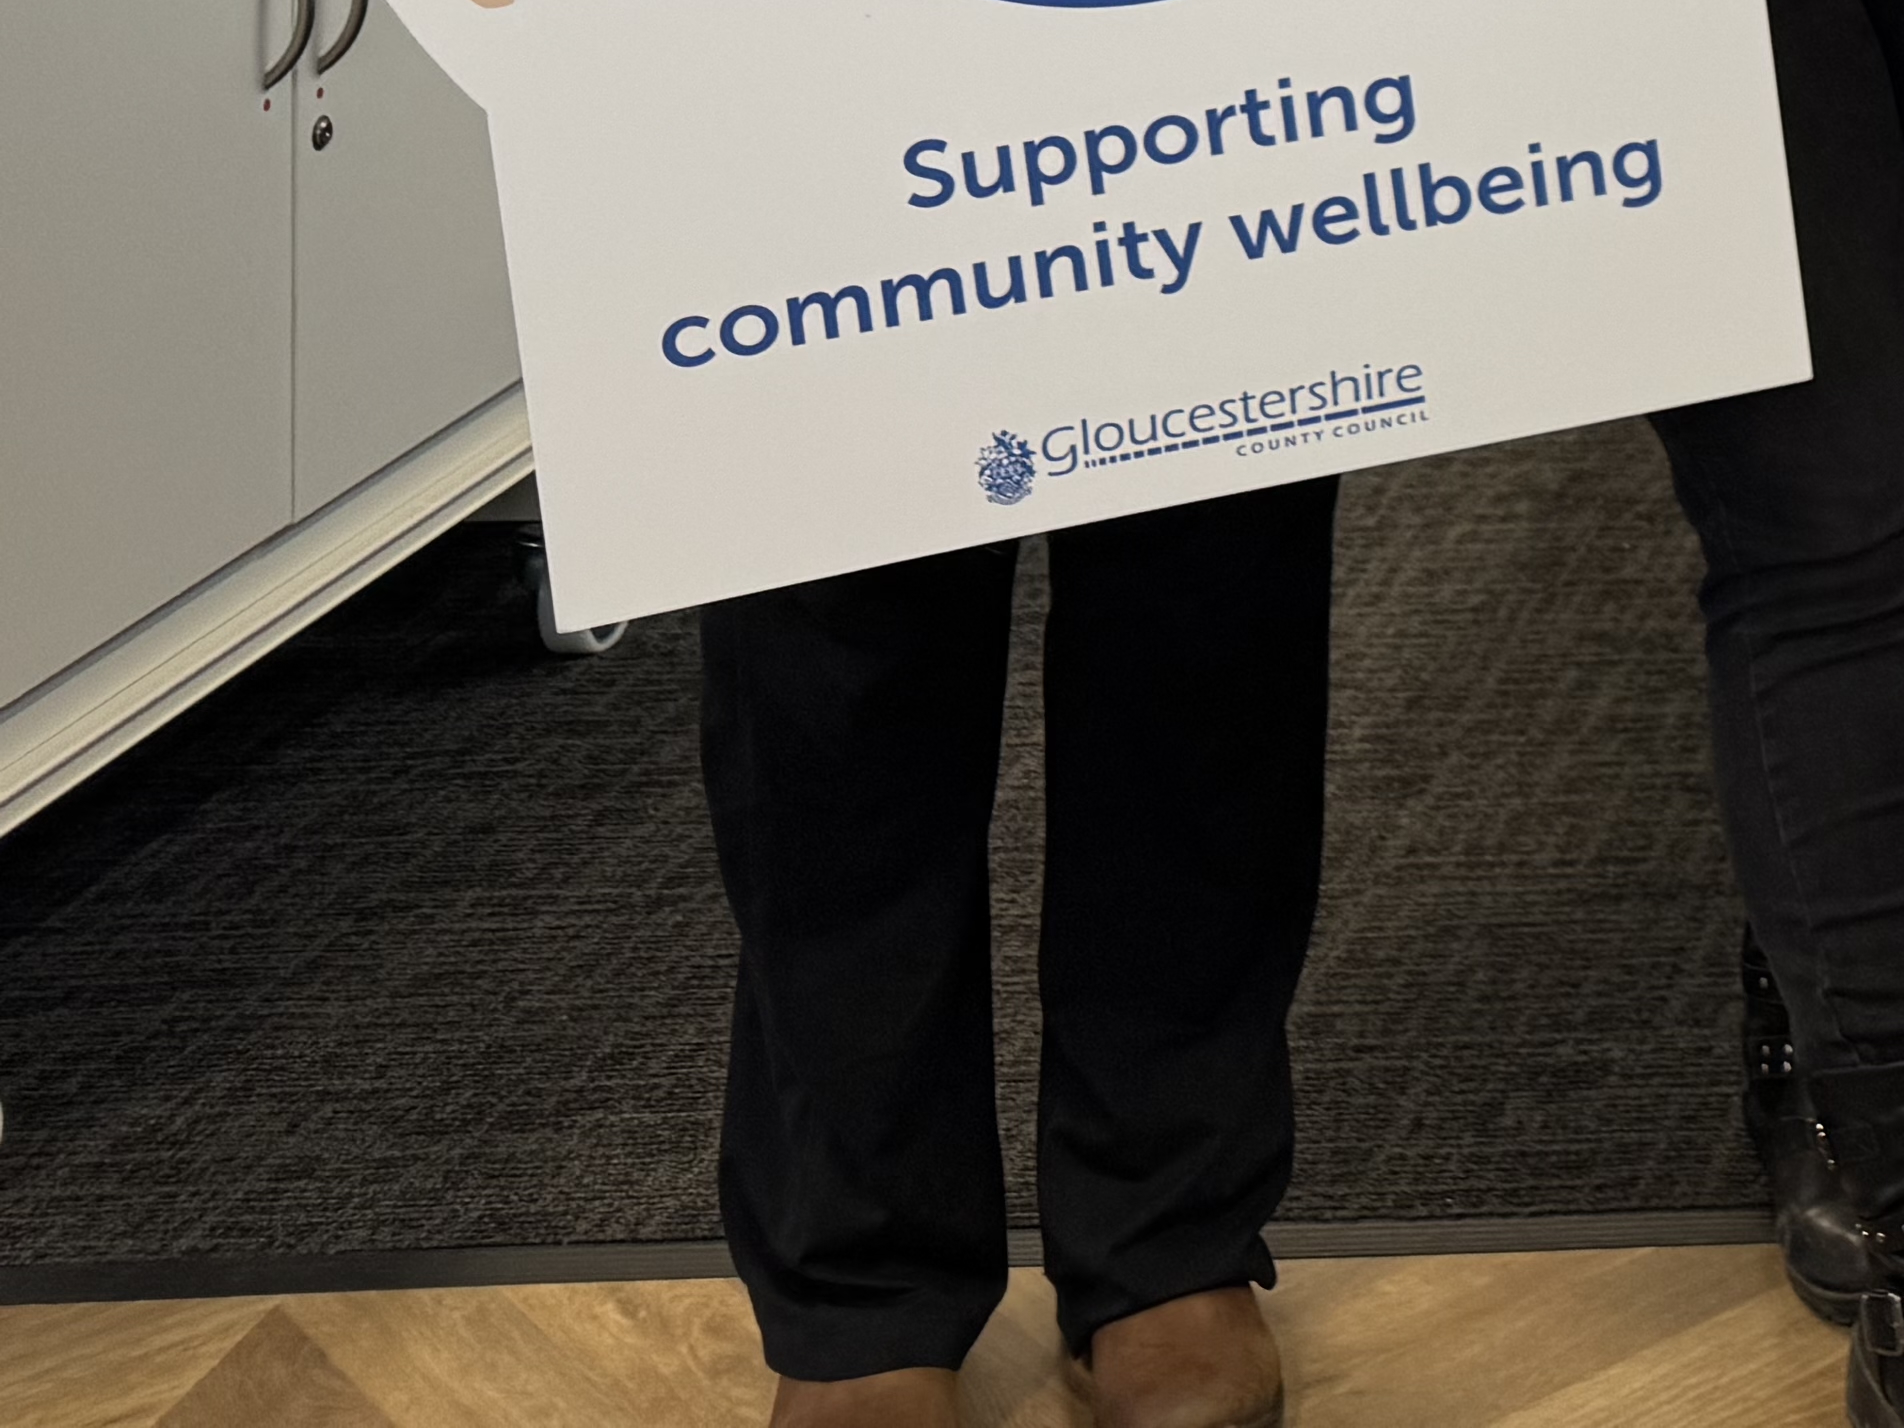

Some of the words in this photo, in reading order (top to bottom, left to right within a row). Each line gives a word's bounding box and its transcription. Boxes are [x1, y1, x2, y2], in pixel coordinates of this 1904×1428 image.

[902, 72, 1418, 210] Supporting
[660, 219, 1202, 369] community
[1230, 136, 1665, 262] wellbeing
[1040, 357, 1425, 478] Gloucestershire
[1235, 430, 1327, 459] COUNTY
[1331, 408, 1430, 441] COUNCIL
